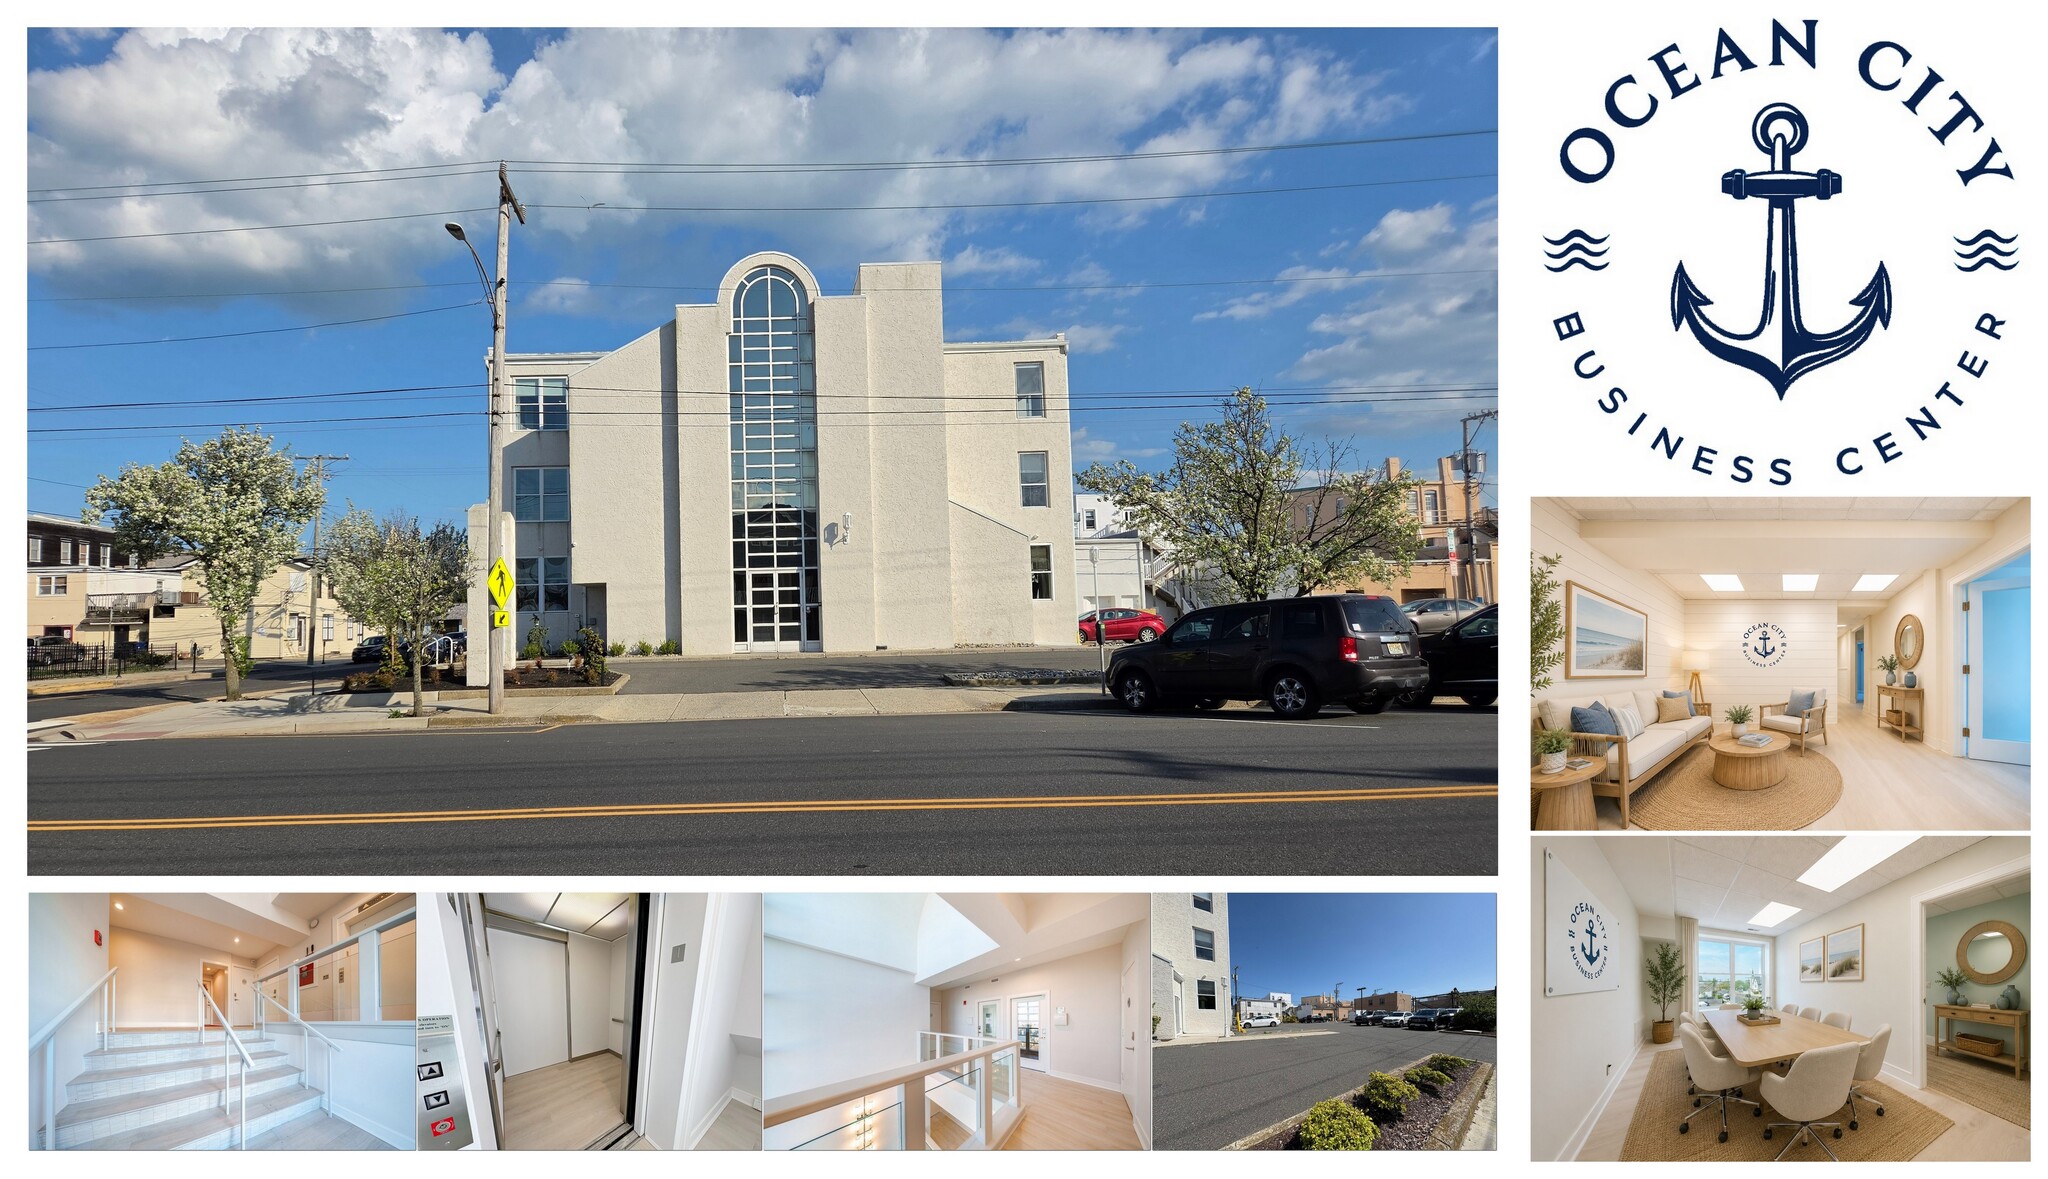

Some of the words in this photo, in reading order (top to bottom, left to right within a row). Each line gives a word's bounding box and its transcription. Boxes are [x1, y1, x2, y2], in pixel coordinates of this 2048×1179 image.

[1743, 622, 1769, 639] OCEAN
[1771, 624, 1786, 639] CITY
[1743, 650, 1767, 667] BUSINESS
[1769, 650, 1786, 667] CENTER
[1570, 902, 1594, 923] OCEAN
[1596, 914, 1607, 939] CITY
[1570, 945, 1594, 980] BUSINESS
[1594, 956, 1607, 979] CENTER
